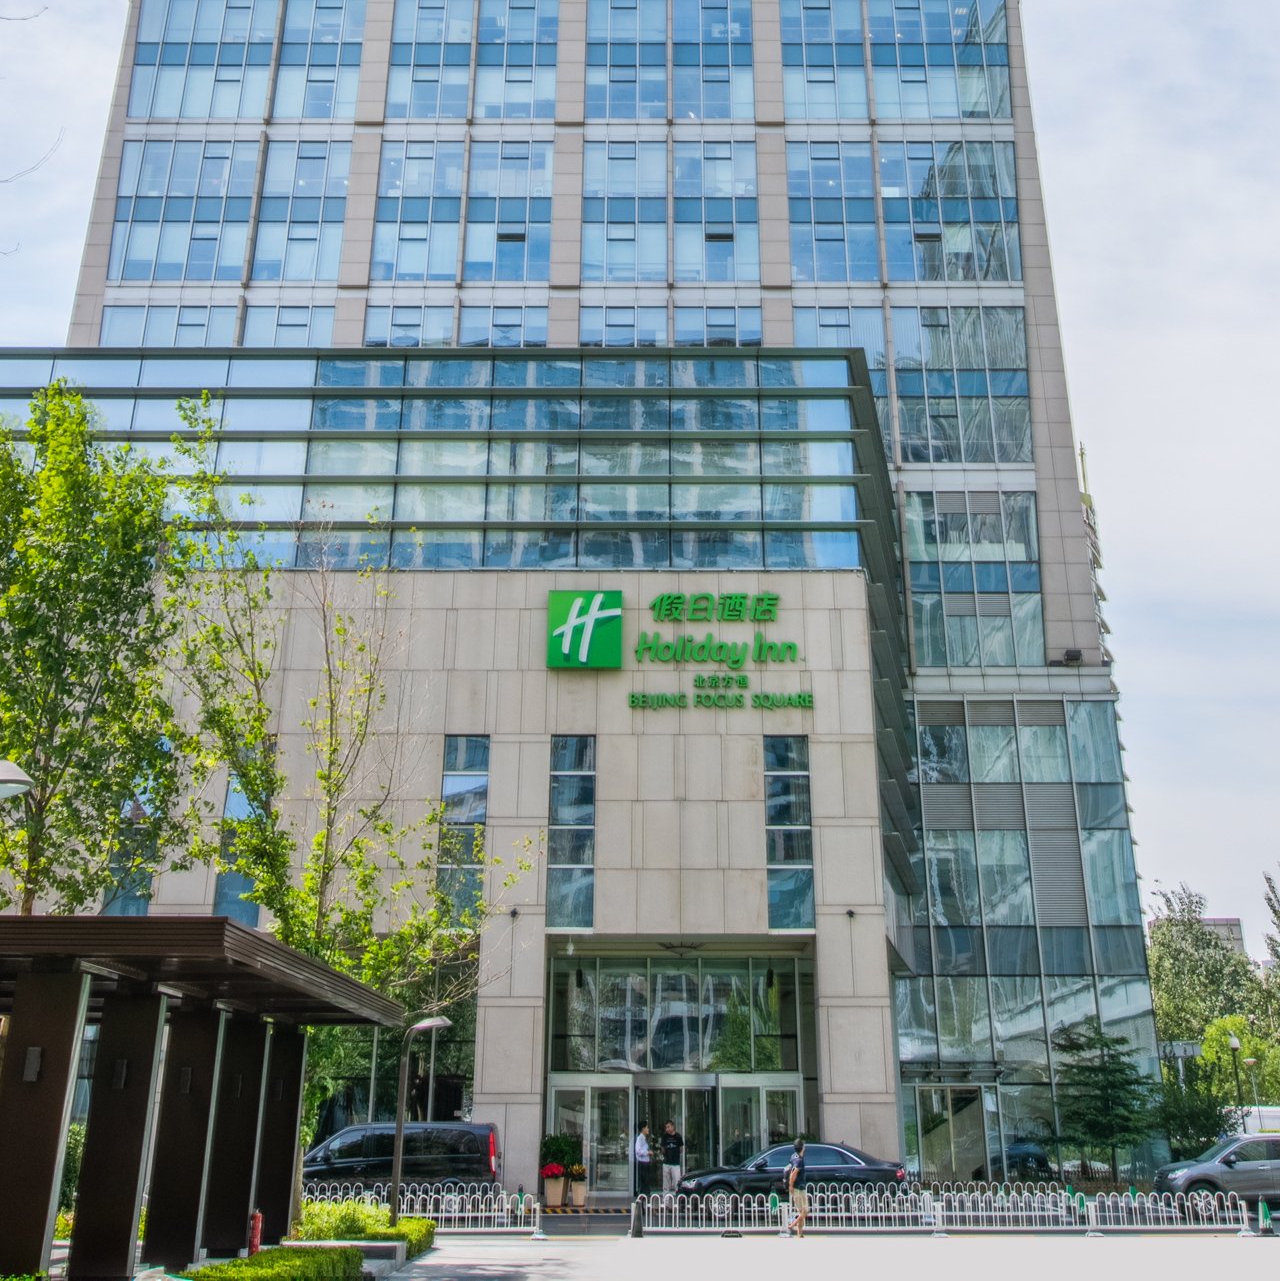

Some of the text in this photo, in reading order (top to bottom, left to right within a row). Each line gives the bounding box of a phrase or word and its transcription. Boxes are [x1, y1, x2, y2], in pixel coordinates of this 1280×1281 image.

[649, 591, 781, 623] 假日酒店
[634, 631, 799, 670] Holiday Inn
[694, 673, 749, 688] 北京方恒
[628, 692, 814, 710] BEIJING FOCUS SQUARE
